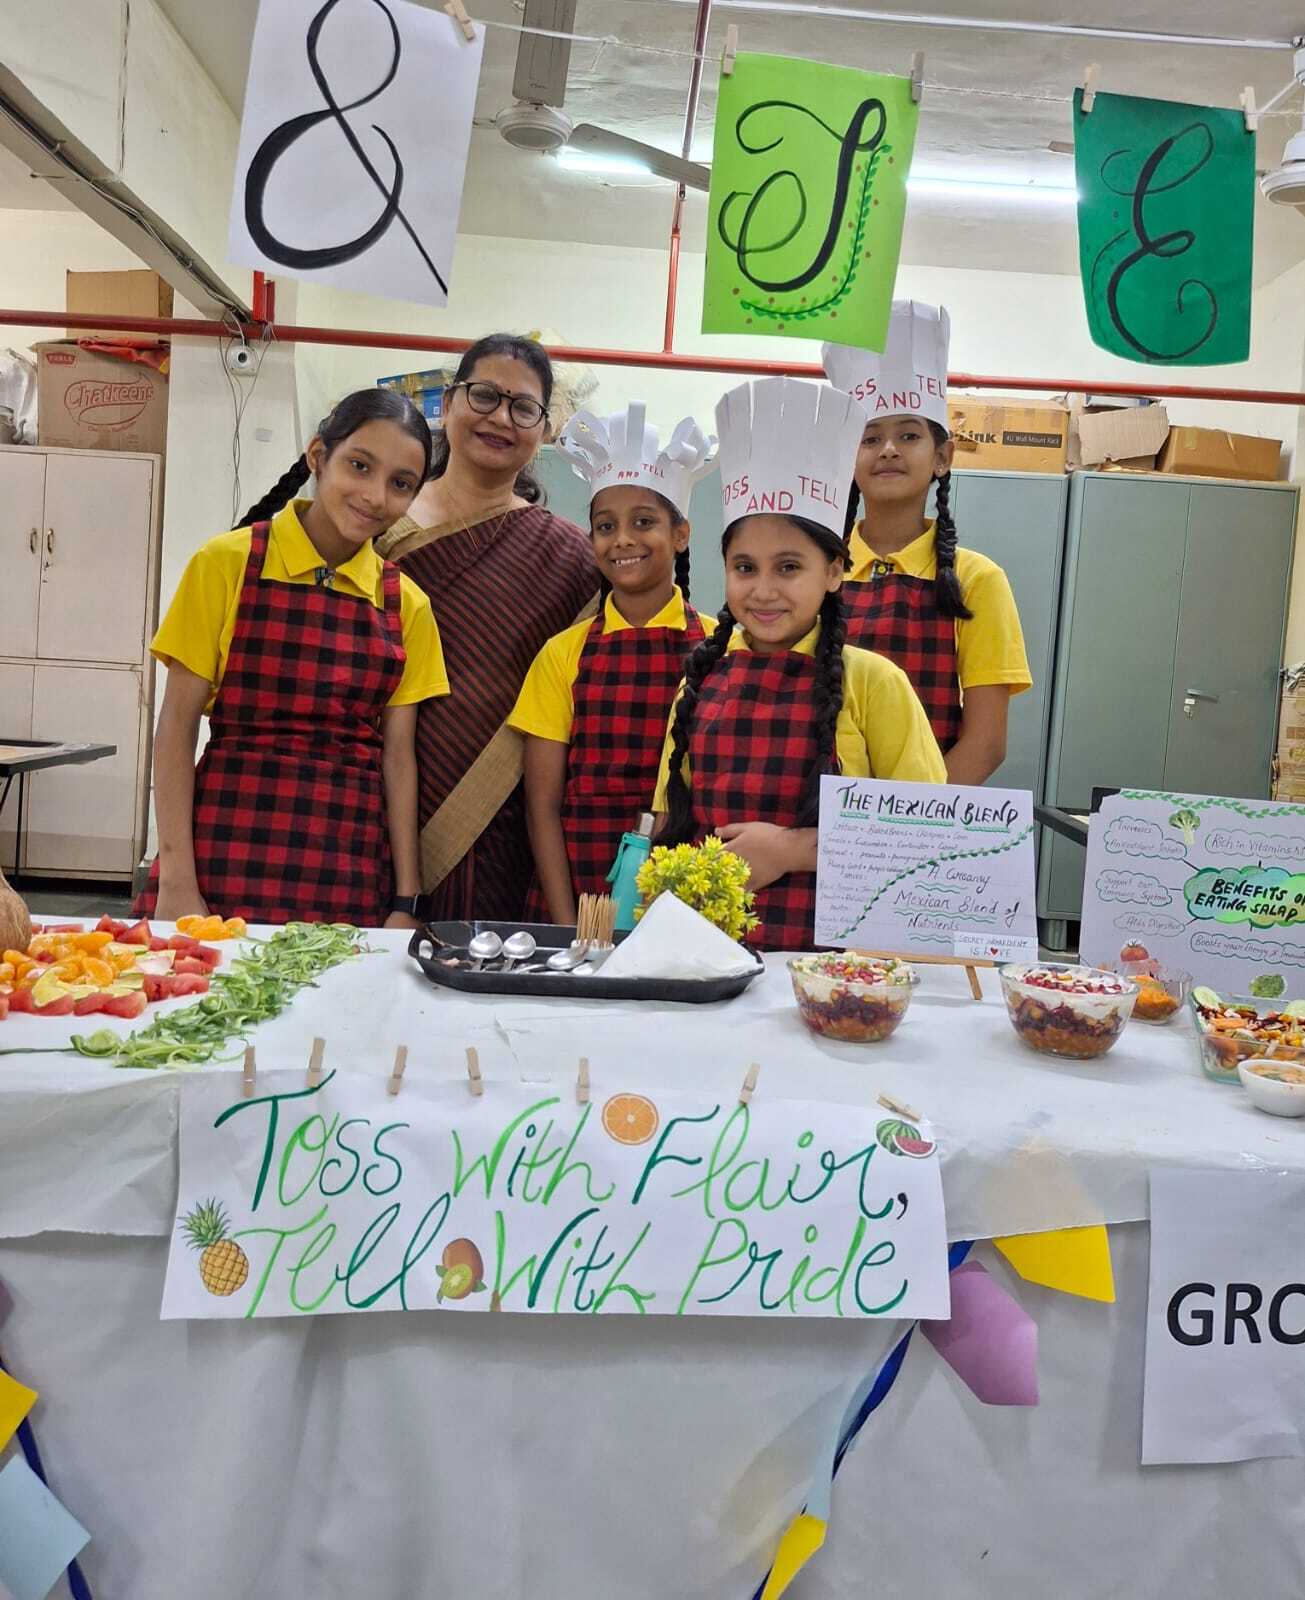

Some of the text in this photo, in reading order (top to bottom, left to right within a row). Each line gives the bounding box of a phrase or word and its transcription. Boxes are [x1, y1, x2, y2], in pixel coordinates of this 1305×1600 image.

[245, 0, 448, 296] &
[1091, 123, 1218, 360] E
[848, 378, 877, 400] SS
[875, 391, 921, 412] AND
[617, 469, 640, 479] AND
[641, 463, 665, 479] TELL
[722, 475, 839, 513] OSS AND TELL
[837, 781, 1019, 827] THE MEXICAN BLEND
[1212, 833, 1233, 849] Rich
[893, 889, 949, 910] Mexican
[958, 895, 999, 914] Blend
[1004, 901, 1020, 928] of
[1211, 878, 1288, 901] BENEFITS
[907, 913, 960, 931] Nutrients
[1249, 903, 1298, 922] SALAD
[213, 1069, 909, 1220] Toss With Flair,
[232, 1191, 909, 1320] Tell With Pride
